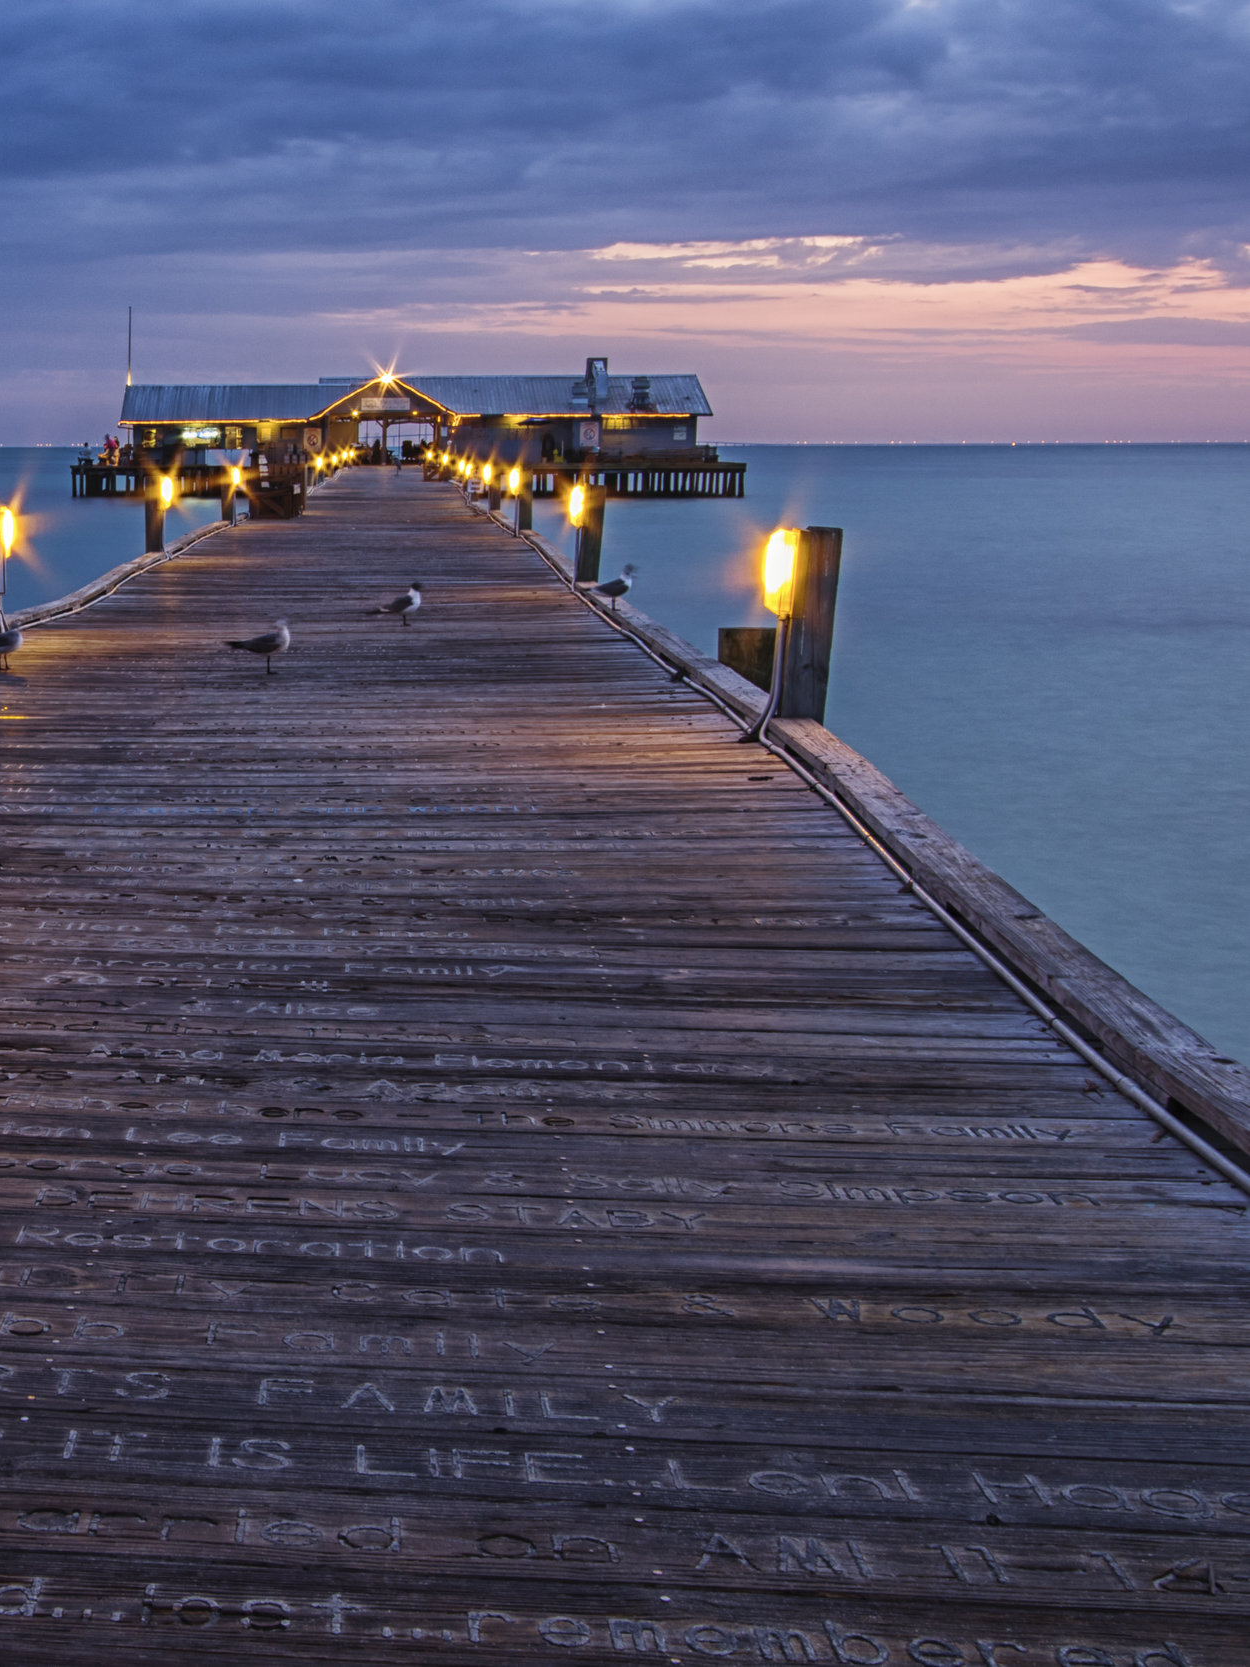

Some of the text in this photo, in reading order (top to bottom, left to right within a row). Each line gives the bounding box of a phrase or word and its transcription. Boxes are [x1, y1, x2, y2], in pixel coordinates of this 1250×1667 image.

[252, 1049, 403, 1064] Maria
[126, 1127, 244, 1145] Lee
[277, 1131, 466, 1156] Family
[462, 1109, 576, 1127] The
[608, 1114, 857, 1134] Simmons
[883, 1121, 1075, 1141] Family
[258, 1160, 440, 1187] Lucy
[484, 1171, 525, 1187] &
[567, 1172, 735, 1199] Sally
[778, 1180, 1103, 1206] Simpson
[33, 1189, 399, 1220] BEHRENS
[445, 1203, 706, 1230] STABY
[16, 1225, 506, 1264] Restoration
[681, 1292, 735, 1317] &
[802, 1297, 1174, 1336] Woody
[205, 1322, 557, 1365] Family
[257, 1378, 678, 1423] FAMILY
[62, 1429, 148, 1462] IT
[206, 1436, 292, 1471] IS
[476, 1533, 620, 1563] on
[694, 1533, 873, 1580] AMI
